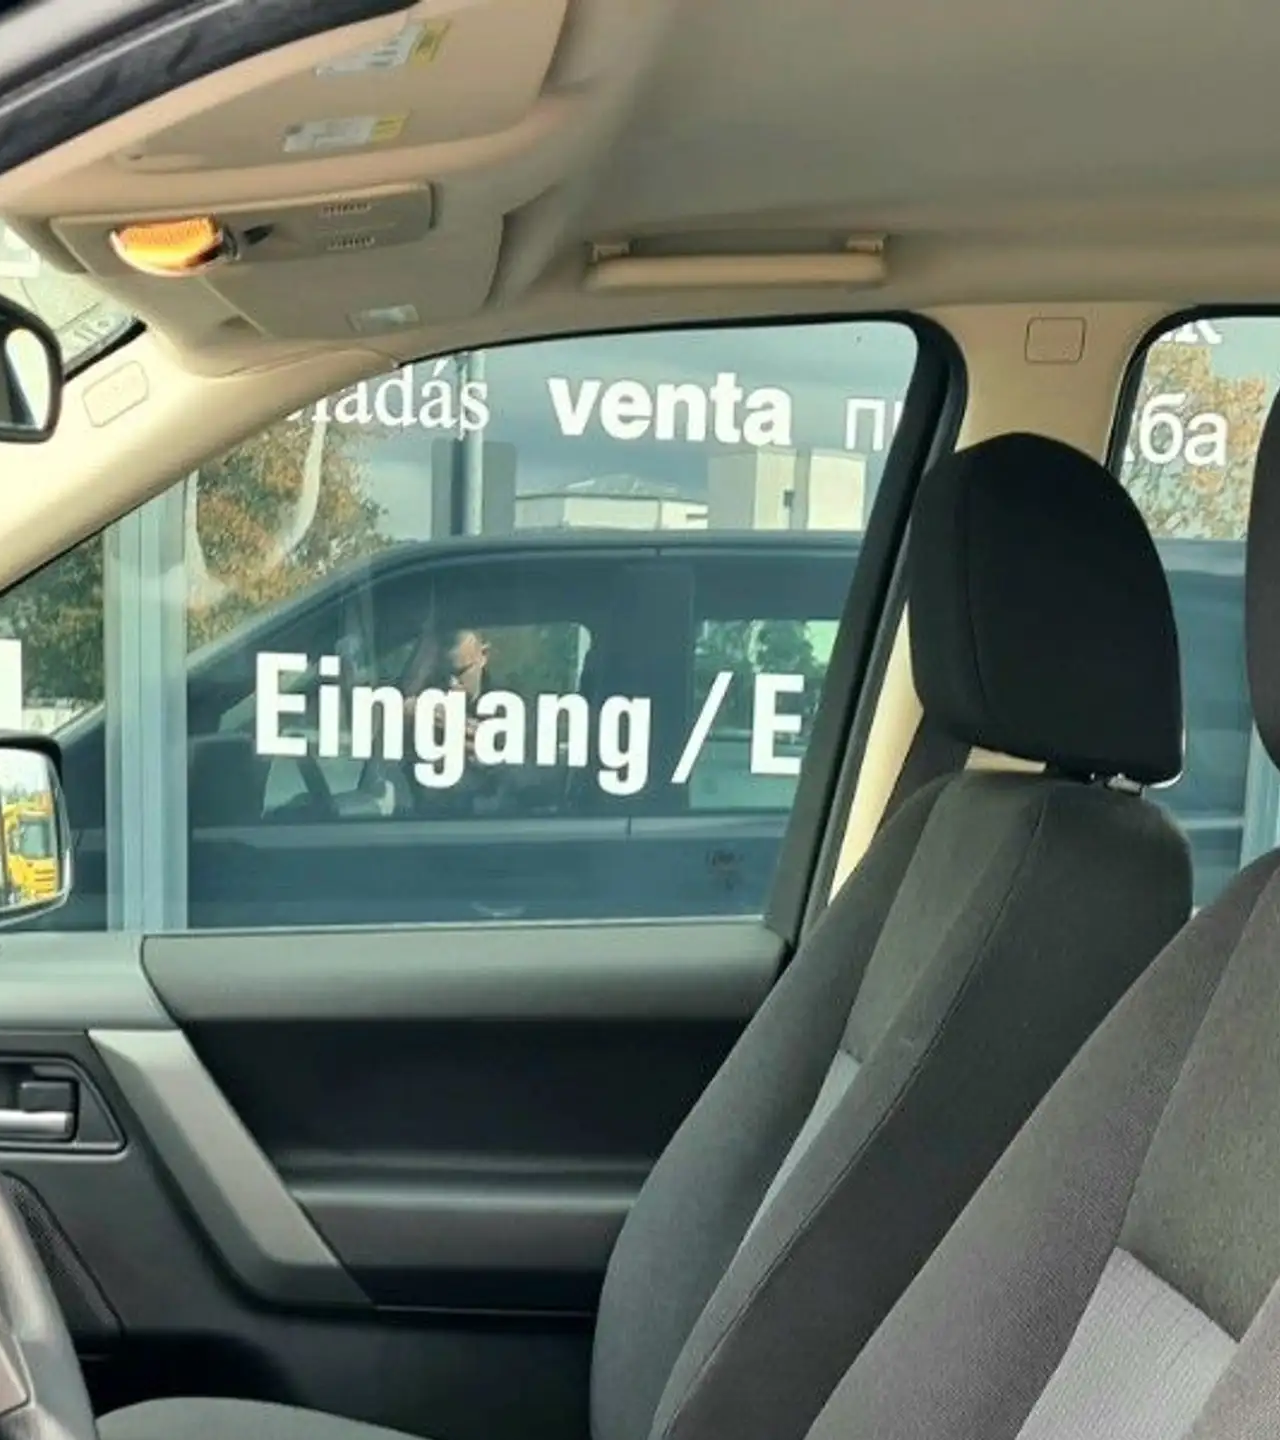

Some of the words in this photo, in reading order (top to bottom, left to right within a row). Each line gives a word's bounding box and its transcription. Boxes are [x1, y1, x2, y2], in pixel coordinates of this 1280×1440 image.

[547, 371, 793, 446] venta
[255, 651, 652, 796] Eingang
[670, 670, 733, 784] /
